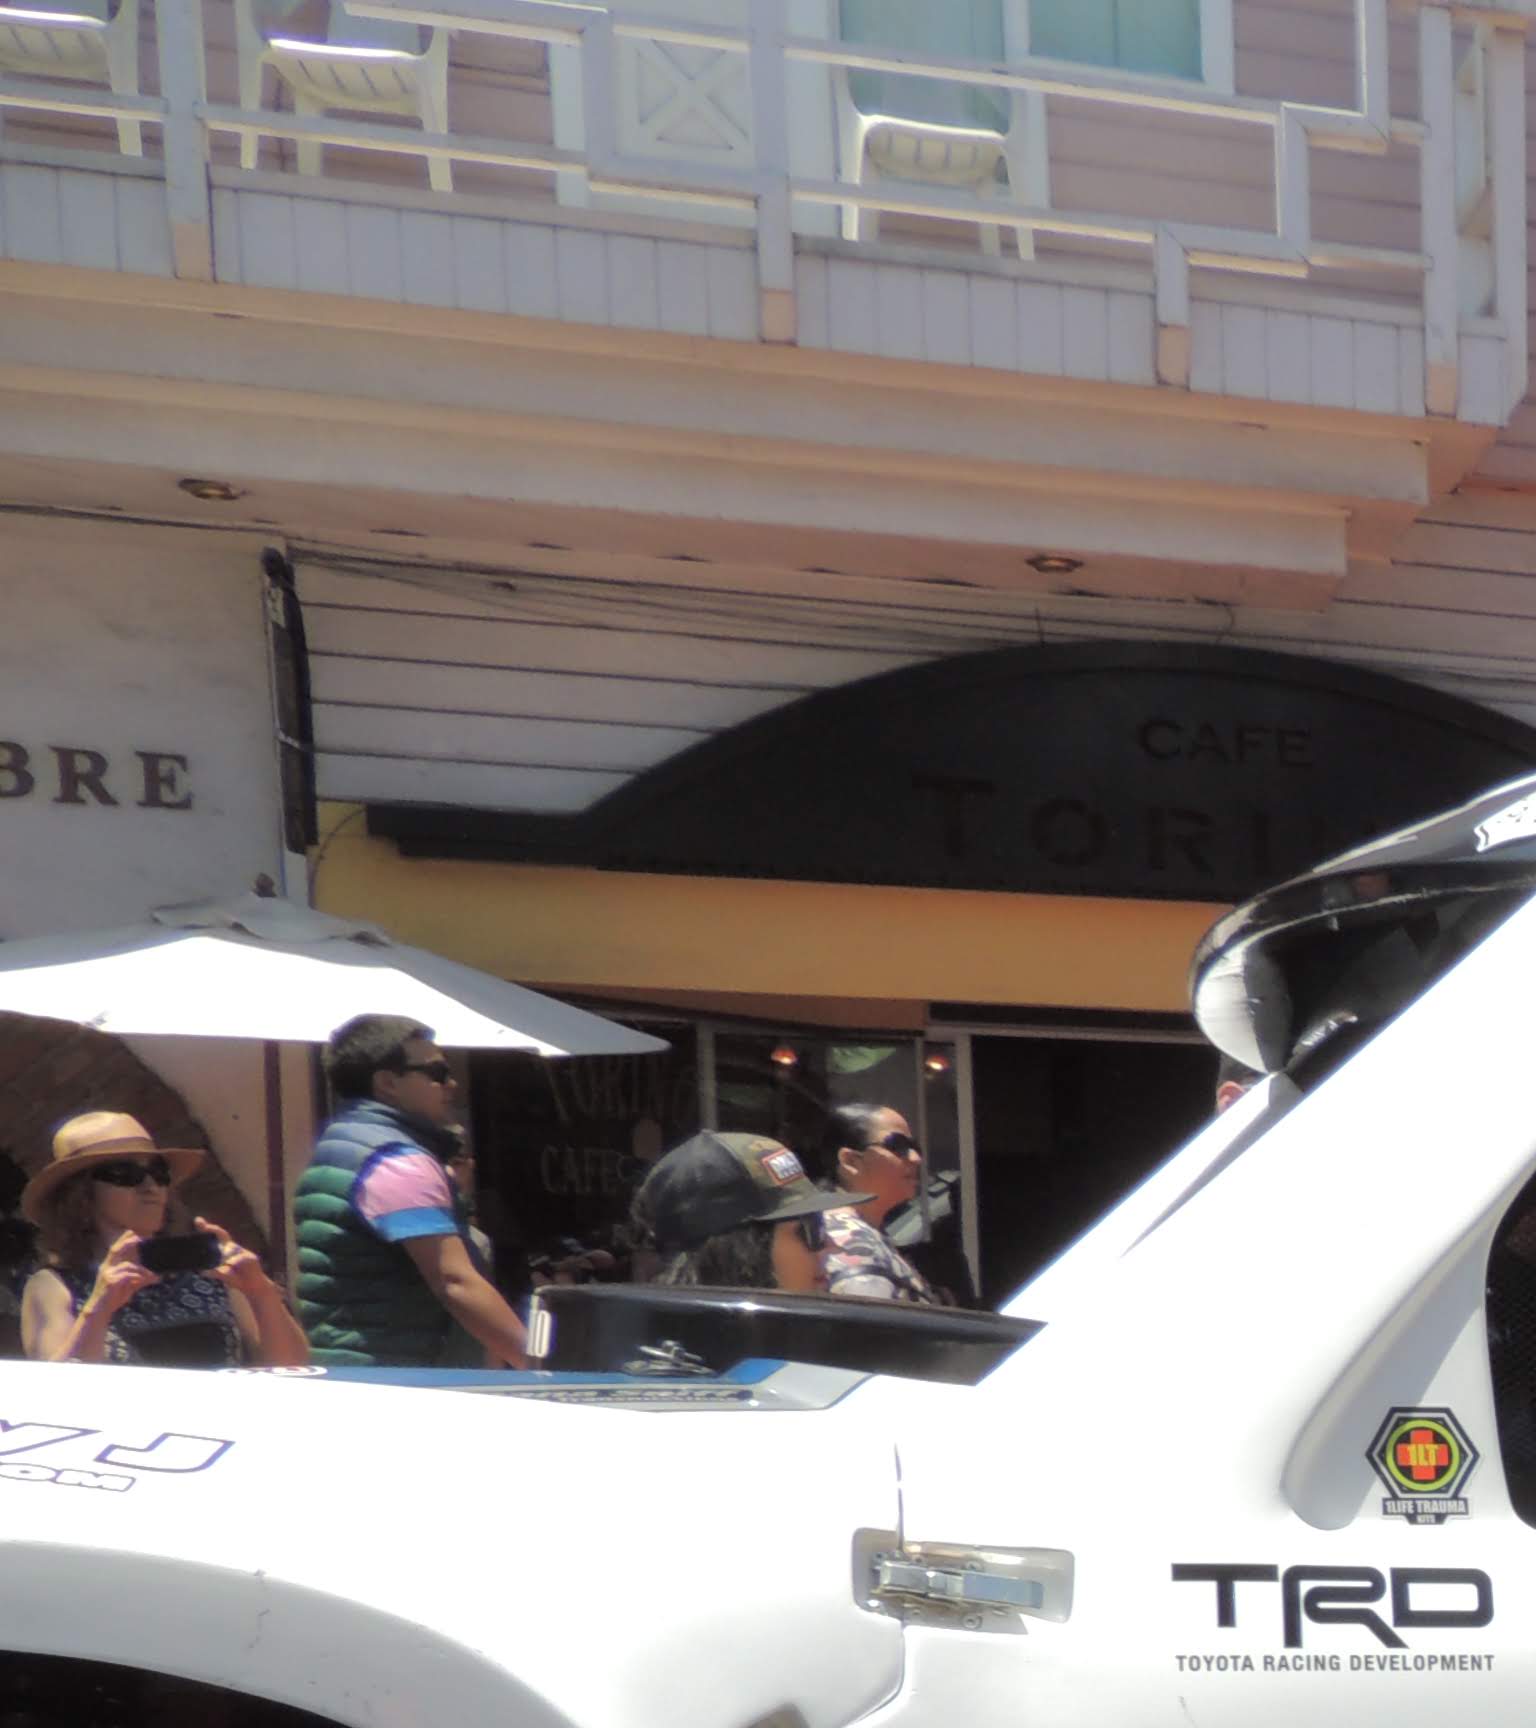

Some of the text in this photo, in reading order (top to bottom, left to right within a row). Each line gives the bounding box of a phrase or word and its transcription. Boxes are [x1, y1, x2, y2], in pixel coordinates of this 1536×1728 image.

[1137, 719, 1313, 768] CAFE
[1416, 1500, 1467, 1514] TRAUMA
[1171, 1563, 1495, 1649] TRD
[1175, 1653, 1496, 1673] TOYOTA RACING DEVELOPMENT
